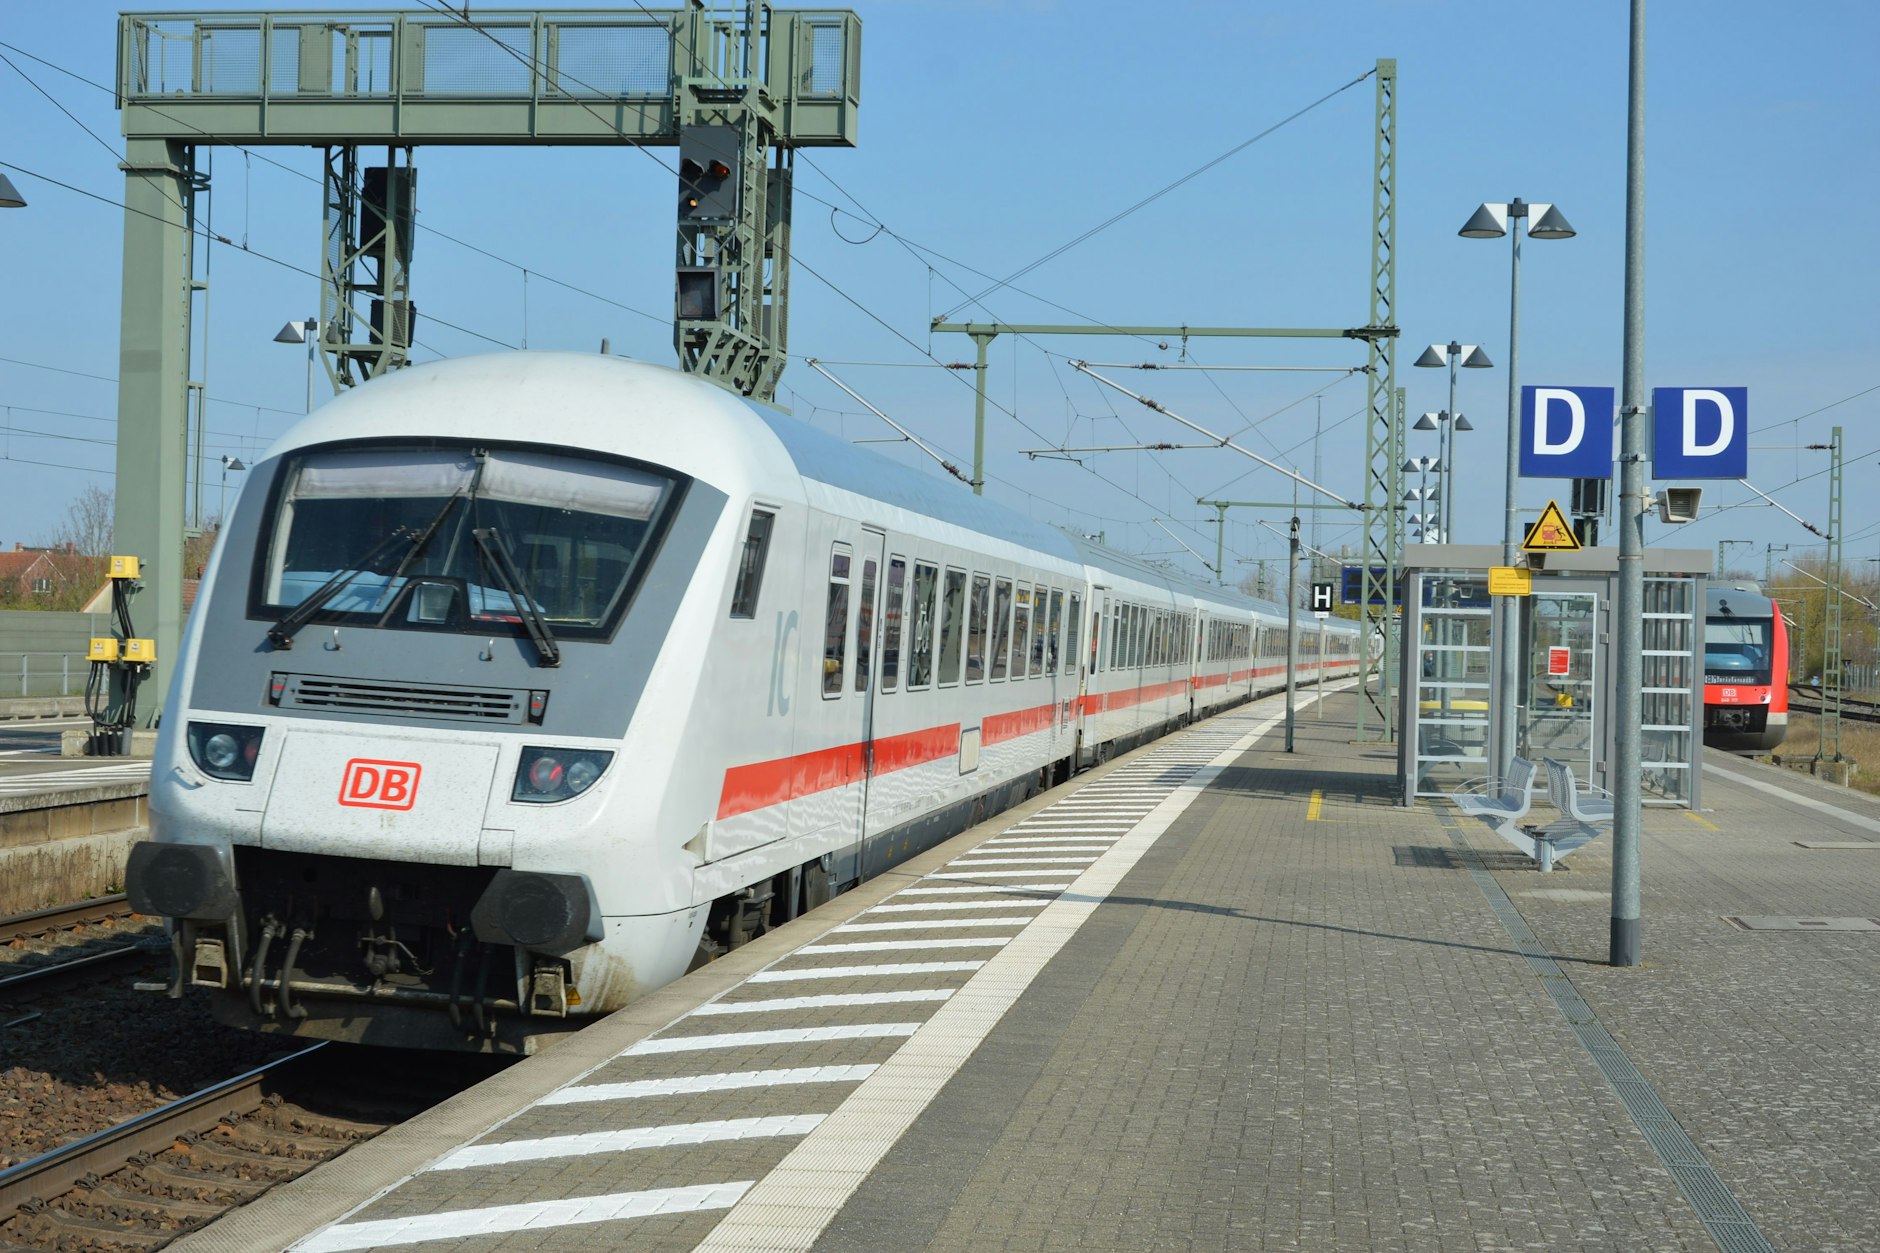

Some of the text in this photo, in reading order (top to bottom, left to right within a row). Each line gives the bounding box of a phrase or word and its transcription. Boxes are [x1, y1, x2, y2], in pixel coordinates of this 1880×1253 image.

[1533, 388, 1585, 455] D
[1683, 389, 1735, 456] D
[1314, 586, 1331, 608] H
[767, 609, 799, 717] IC
[347, 765, 411, 803] DB
